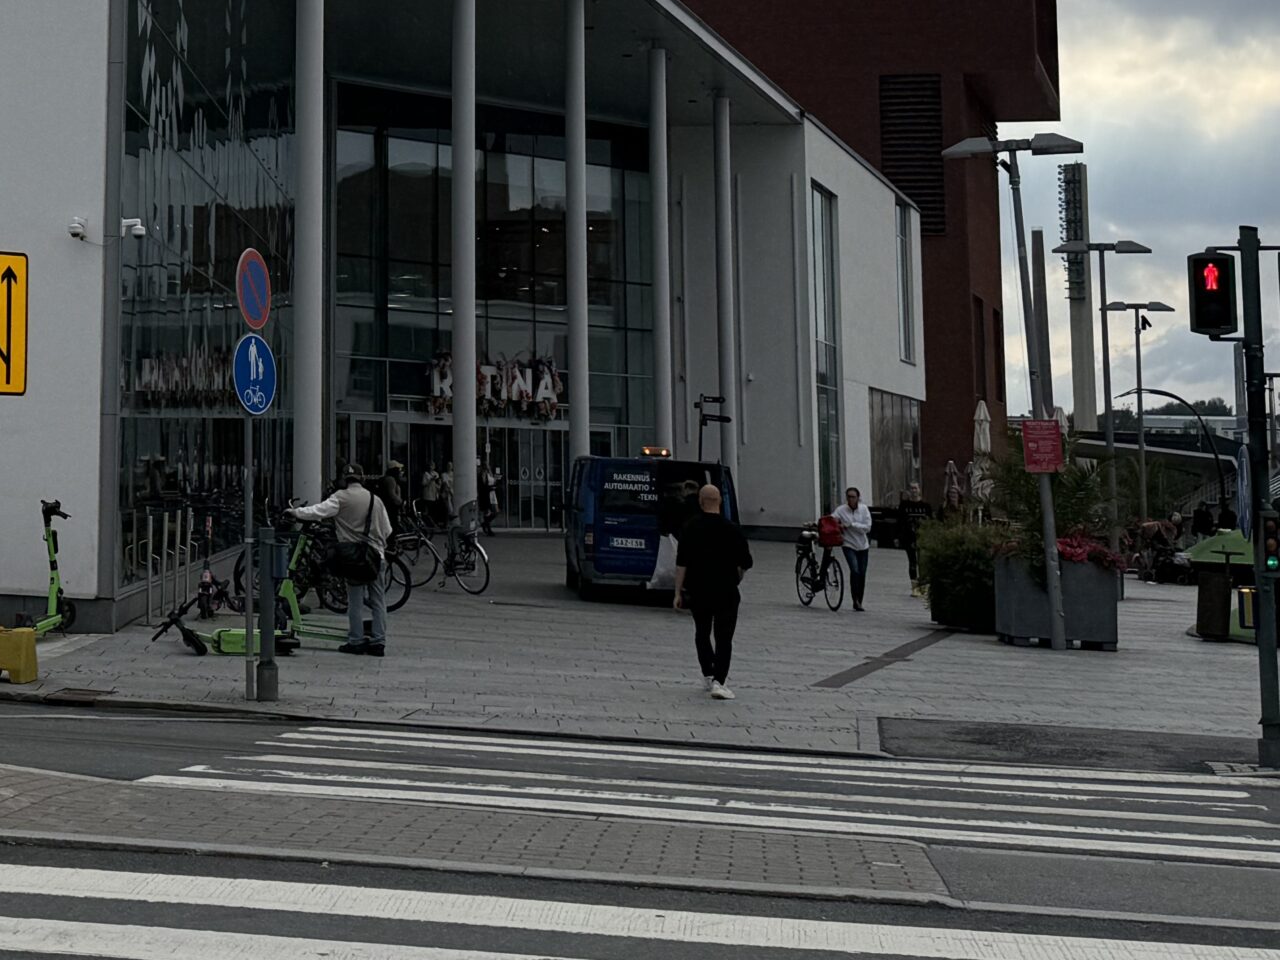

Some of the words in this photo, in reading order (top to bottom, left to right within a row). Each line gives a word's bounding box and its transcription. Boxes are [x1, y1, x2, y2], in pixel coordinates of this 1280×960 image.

[433, 365, 558, 402] RTINA
[613, 473, 650, 482] RAKENNUS
[604, 482, 650, 491] AUTOMAATIO
